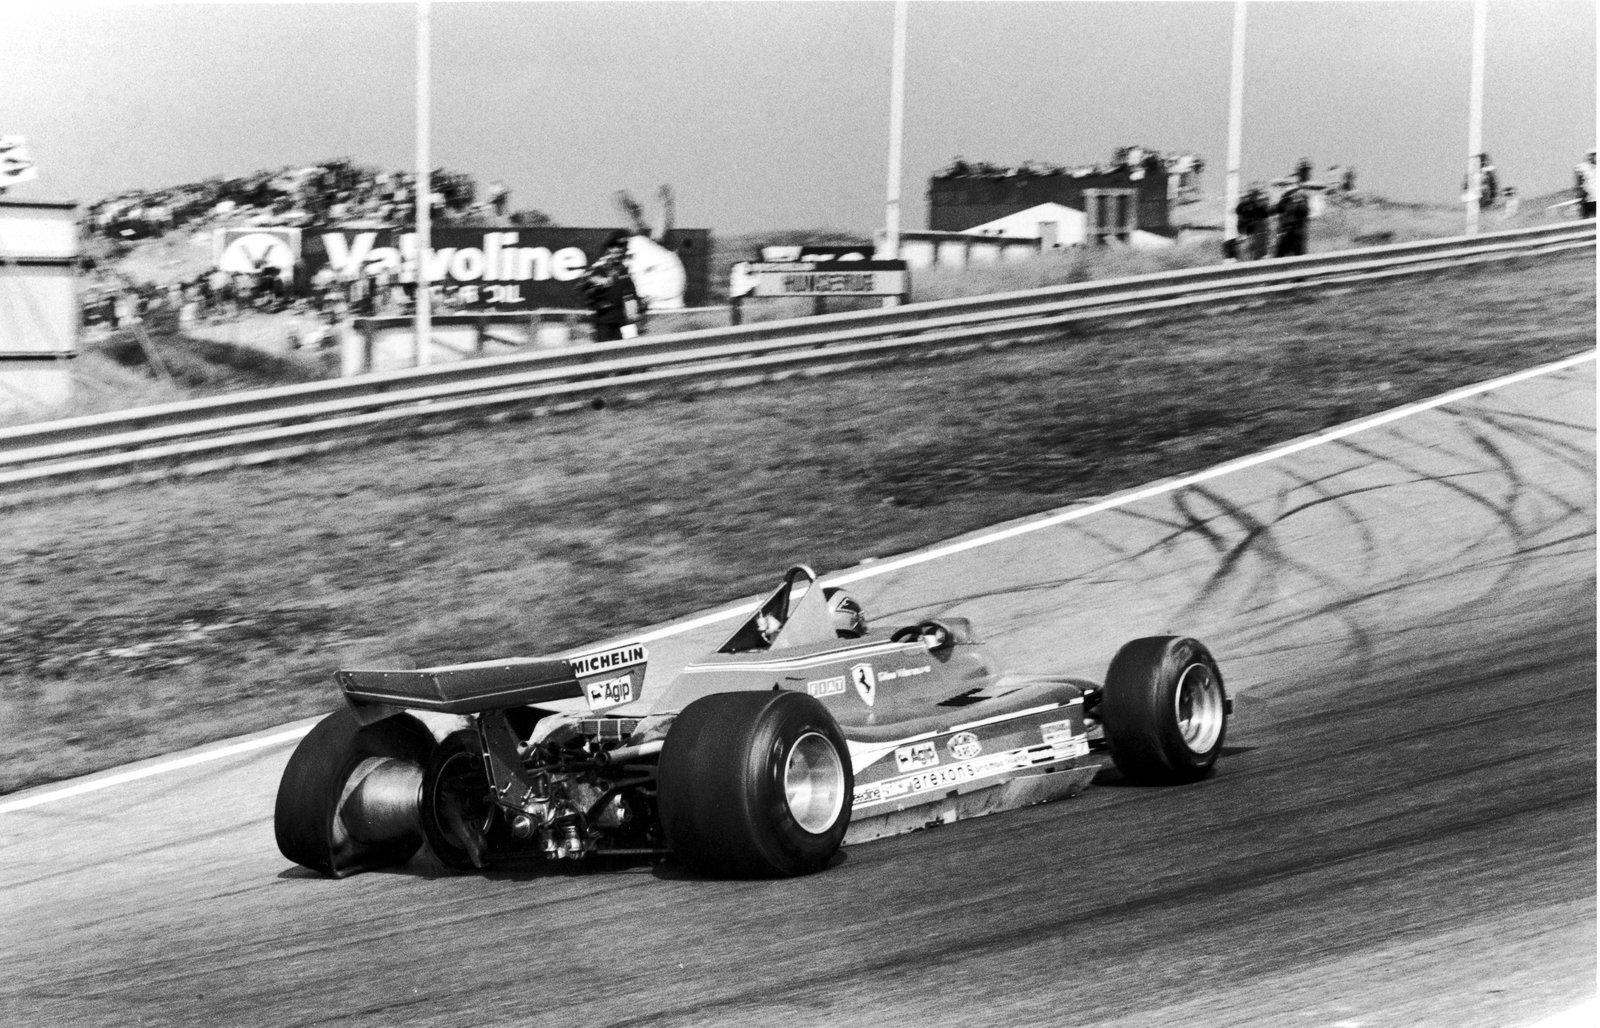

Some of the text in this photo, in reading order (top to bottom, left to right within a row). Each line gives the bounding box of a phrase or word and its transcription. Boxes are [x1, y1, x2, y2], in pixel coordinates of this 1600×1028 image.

[322, 232, 587, 282] Valvoline
[572, 647, 644, 674] MICHELIN
[605, 679, 630, 702] Agip
[809, 677, 844, 696] FIAT
[912, 763, 975, 790] arexons
[854, 787, 881, 802] eedline
